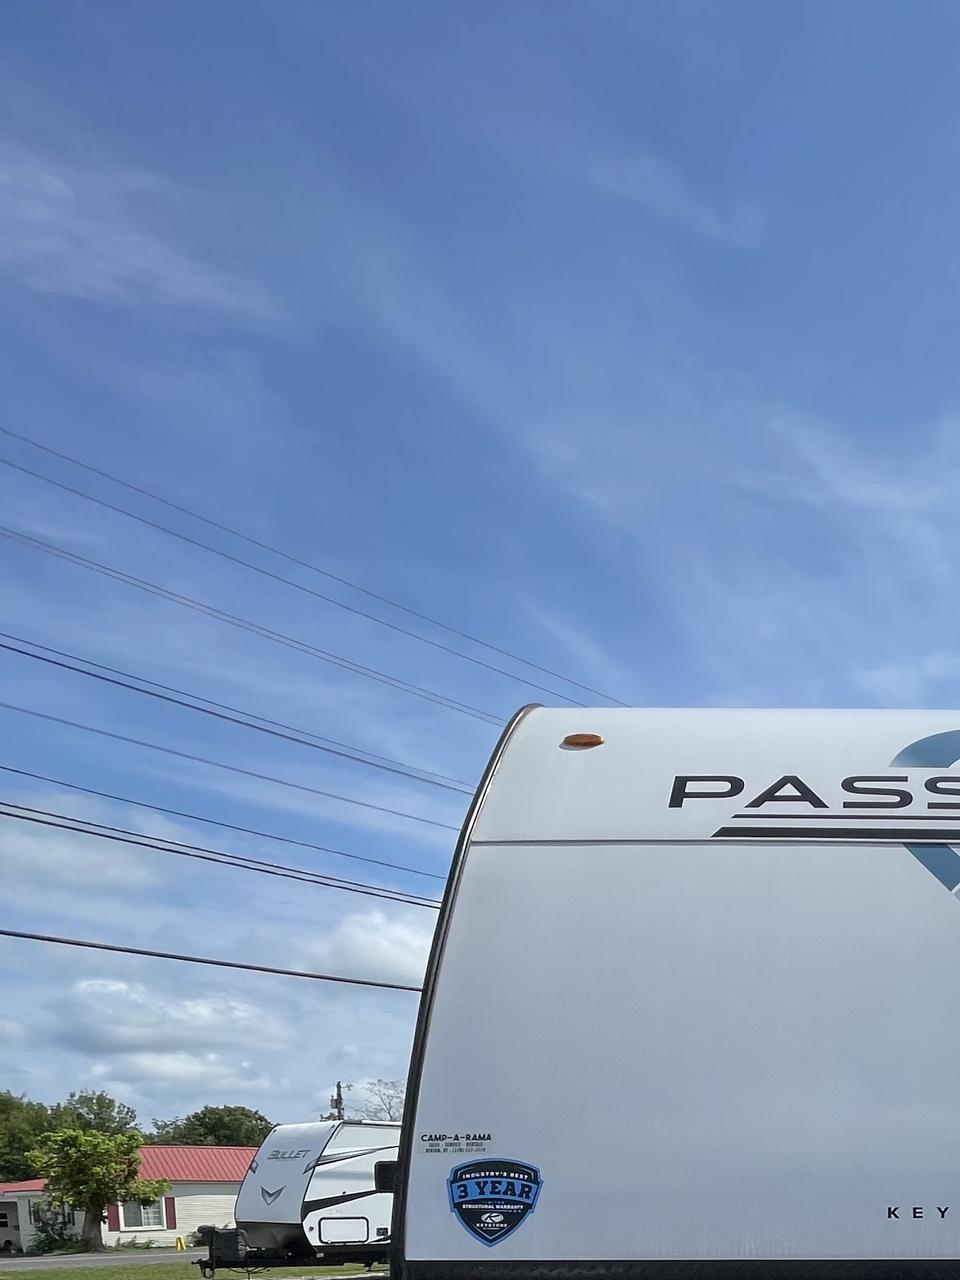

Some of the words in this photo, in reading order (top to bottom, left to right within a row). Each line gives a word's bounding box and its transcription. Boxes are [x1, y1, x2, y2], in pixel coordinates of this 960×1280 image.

[421, 1133, 492, 1142] CAMP-A-RAMA
[267, 1149, 311, 1160] BULLET
[456, 1183, 469, 1199] 3
[475, 1181, 533, 1199] YEAR
